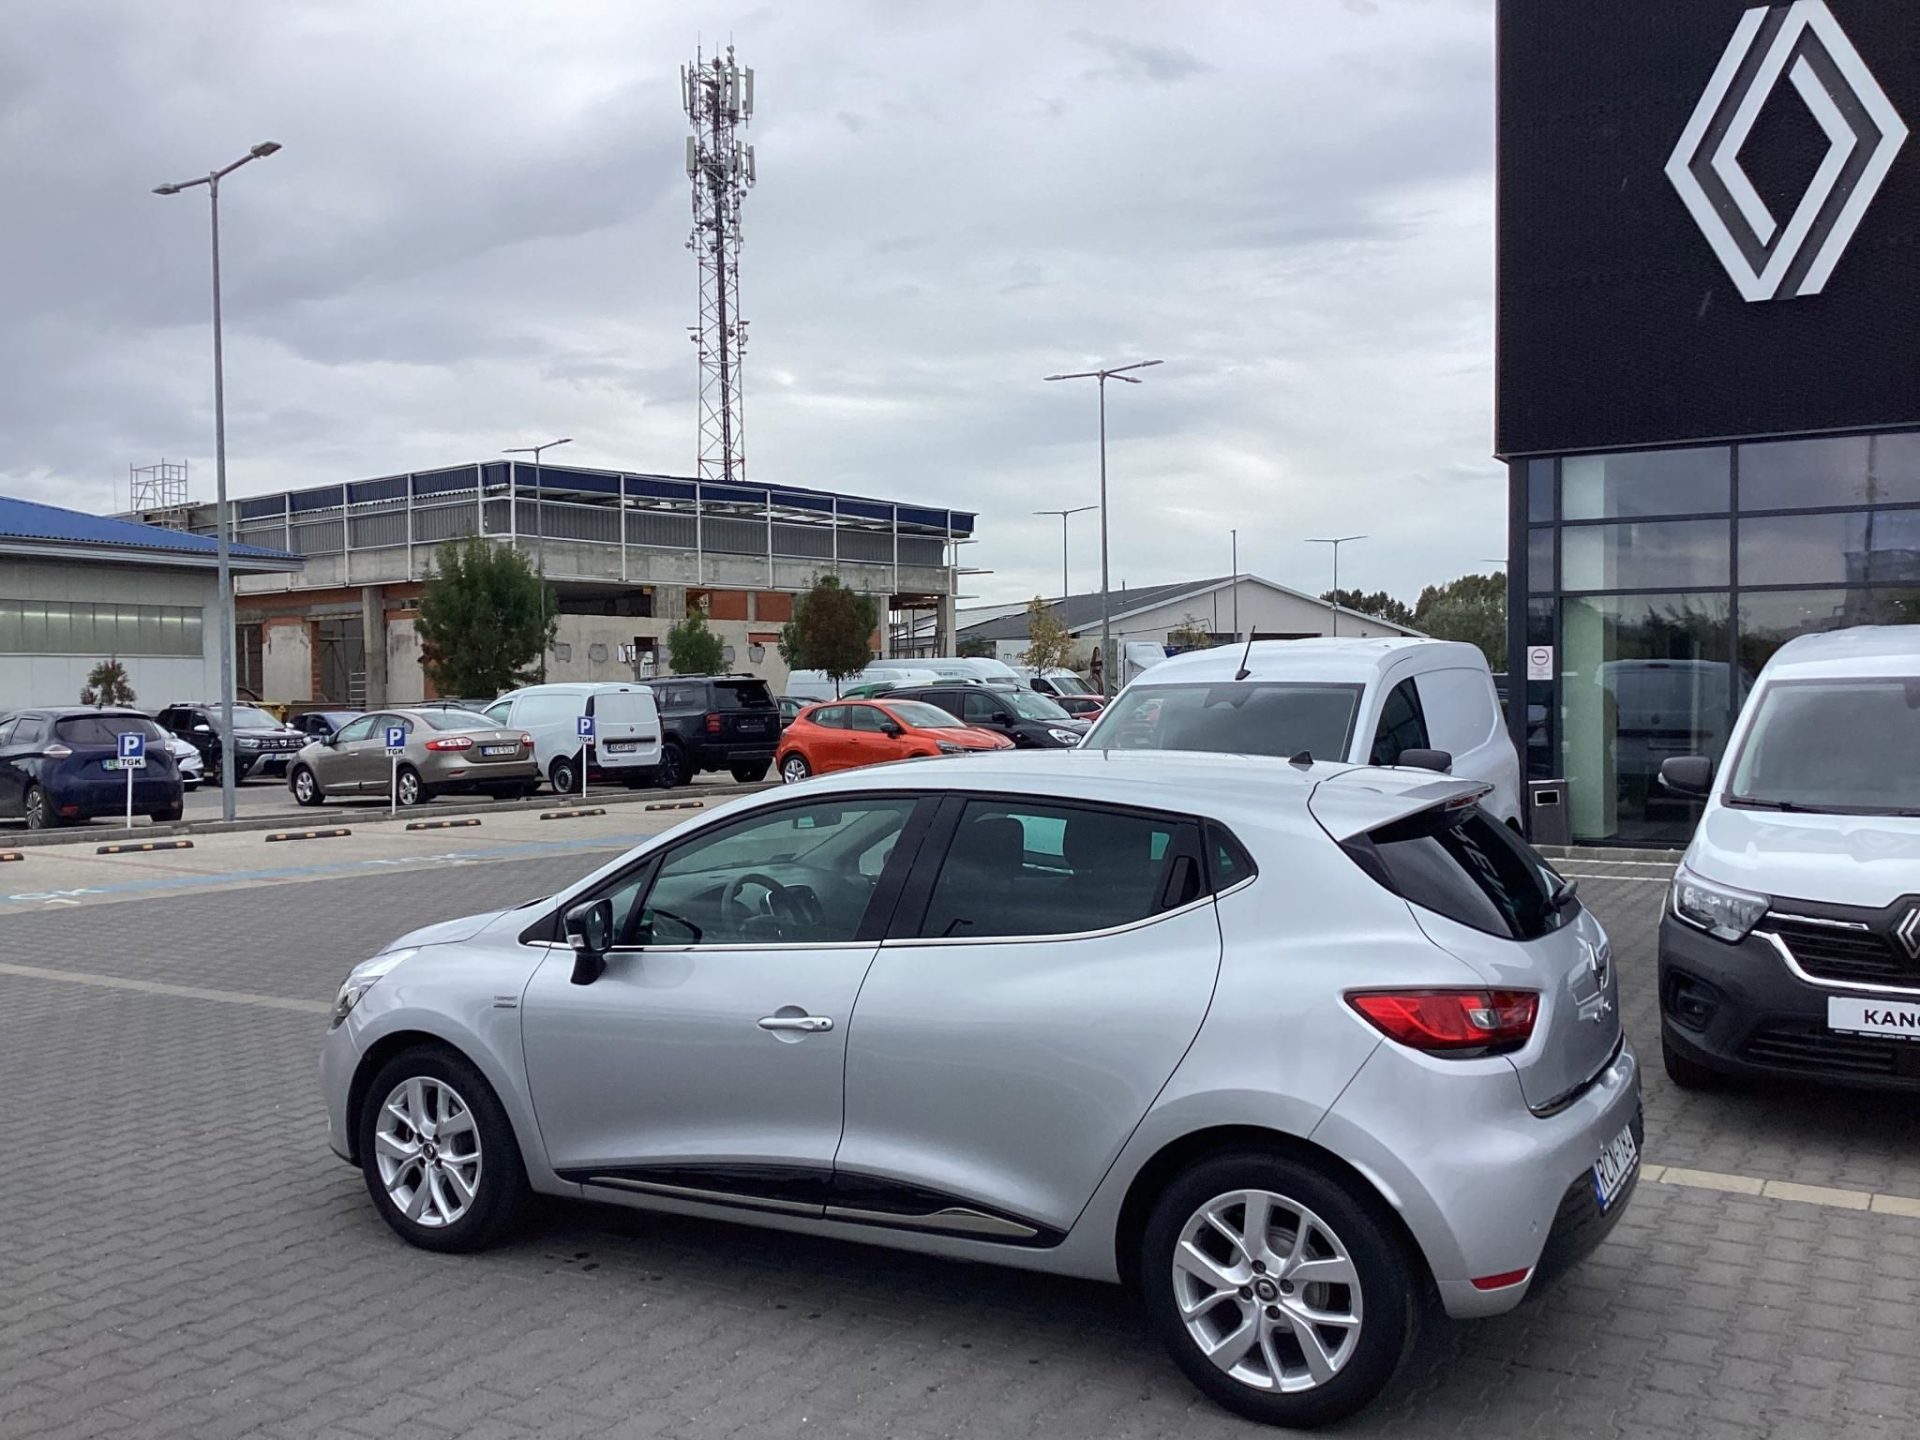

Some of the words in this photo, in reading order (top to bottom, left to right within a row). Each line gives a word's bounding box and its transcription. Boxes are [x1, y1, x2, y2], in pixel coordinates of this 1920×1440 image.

[580, 718, 591, 734] P
[124, 735, 140, 756] P
[389, 728, 402, 746] P
[120, 758, 142, 766] TGK
[1864, 1009, 1920, 1028] KAN
